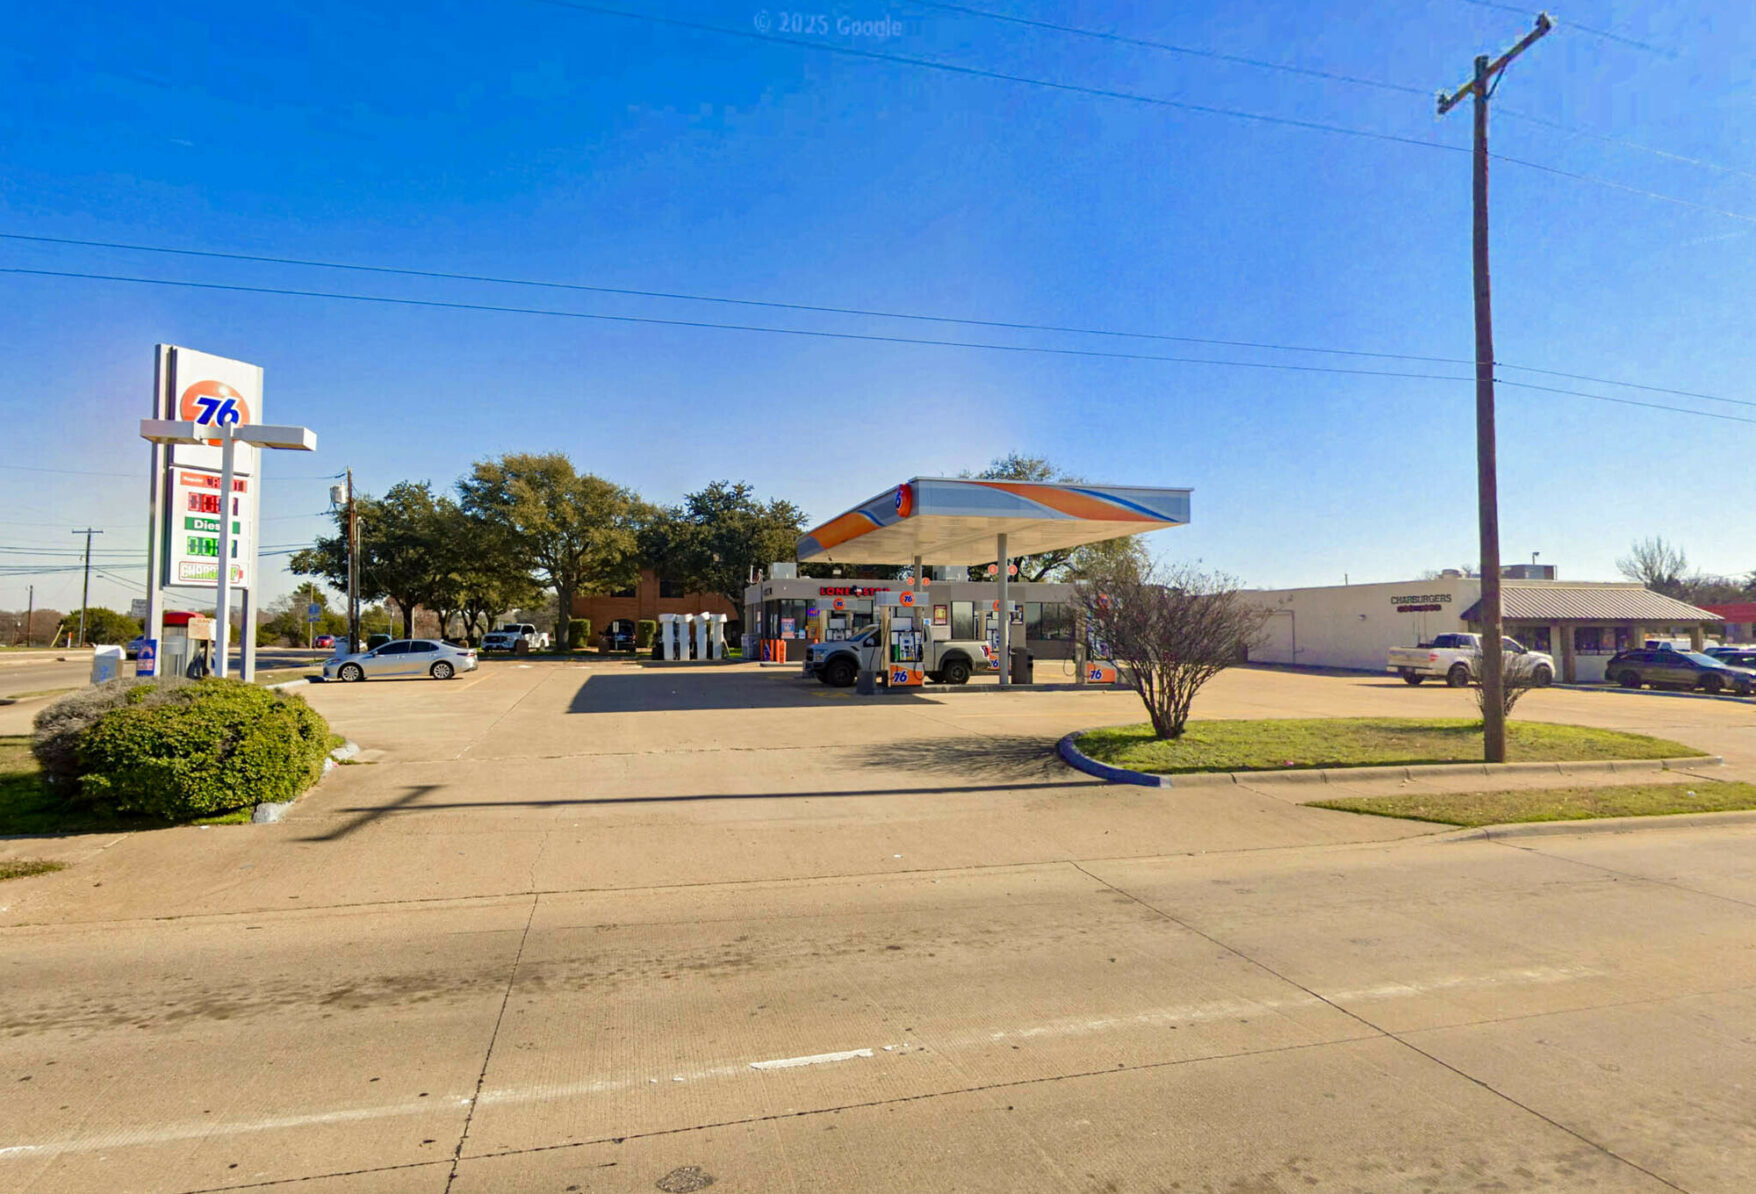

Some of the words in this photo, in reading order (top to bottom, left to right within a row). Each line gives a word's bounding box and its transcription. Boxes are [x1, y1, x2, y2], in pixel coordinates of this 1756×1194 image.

[196, 396, 239, 427] 76
[194, 519, 220, 531] Dies
[820, 586, 850, 597] LONE
[1391, 594, 1452, 604] CHARBURGERS
[893, 670, 908, 683] 76
[1089, 669, 1103, 680] 76
